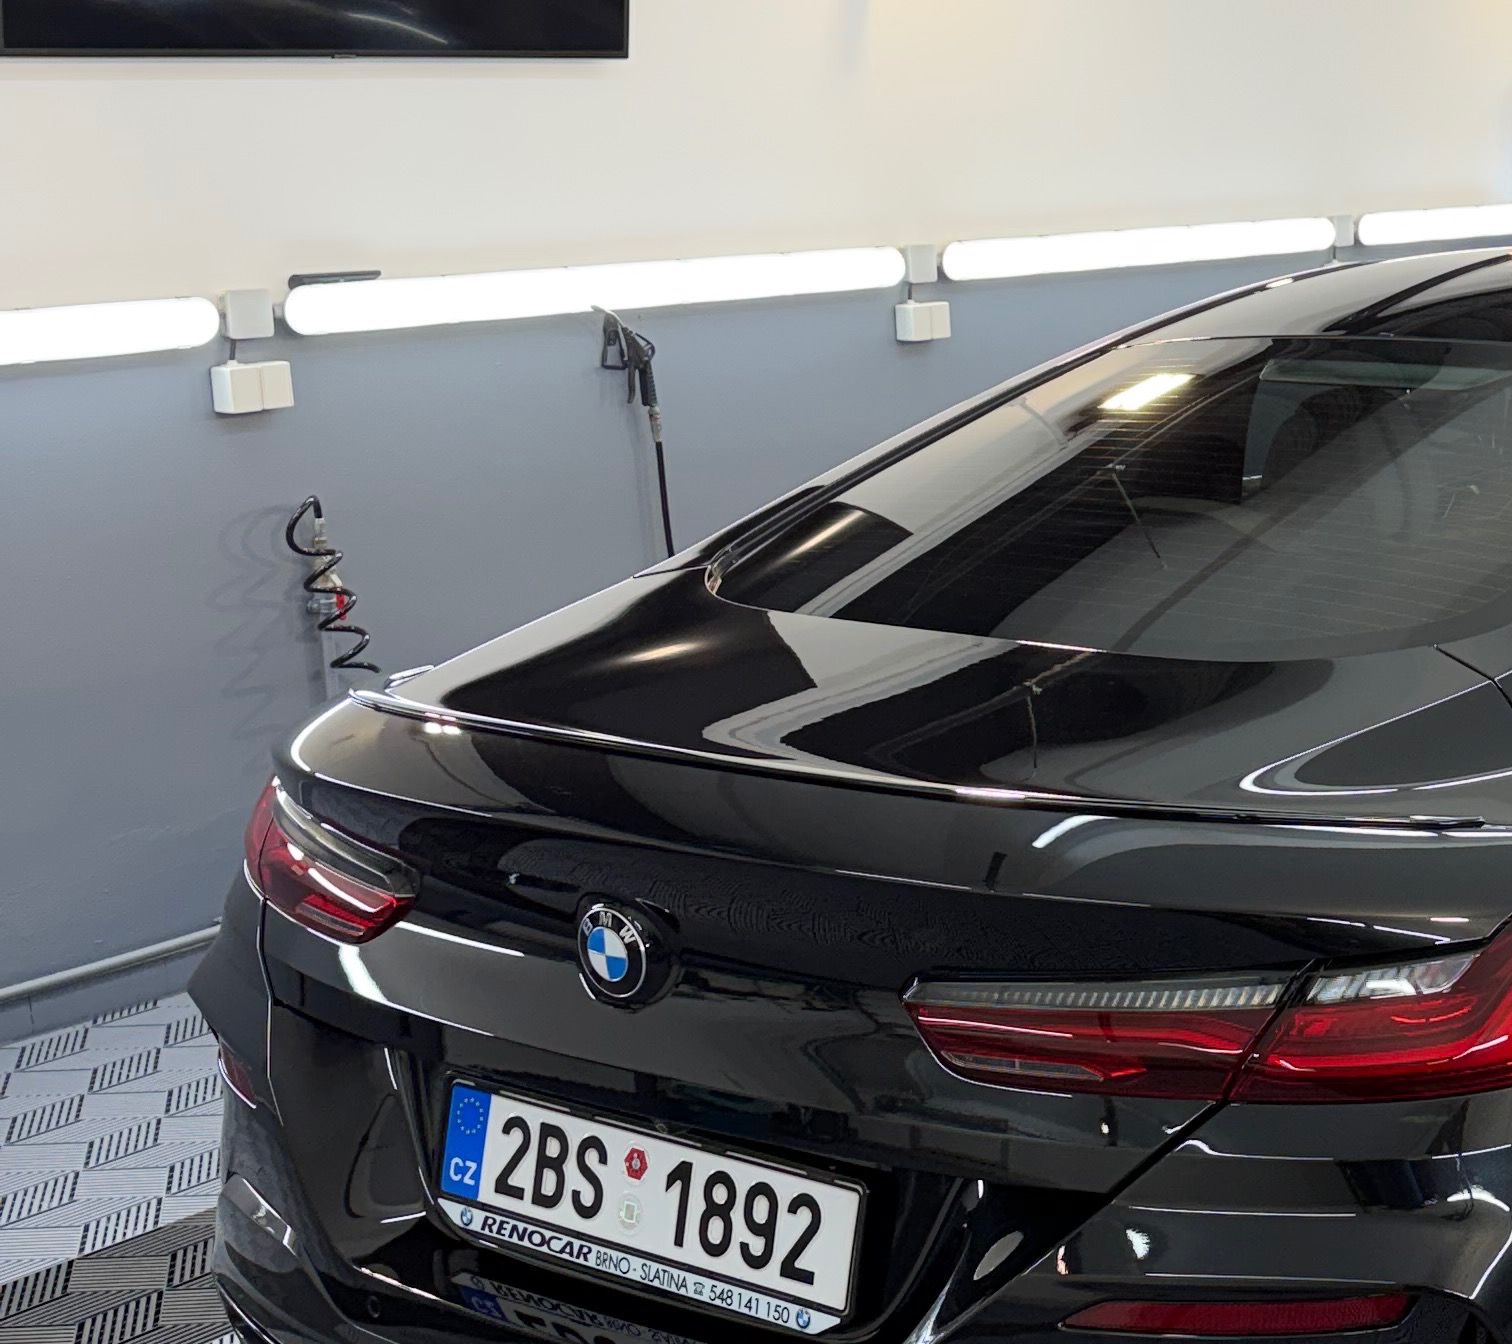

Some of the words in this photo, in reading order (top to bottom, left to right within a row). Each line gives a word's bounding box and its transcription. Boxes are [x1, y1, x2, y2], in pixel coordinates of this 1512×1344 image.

[582, 911, 637, 945] BMW
[450, 1156, 478, 1186] CZ
[494, 1115, 608, 1220] 2BS
[665, 1160, 823, 1286] 1892
[480, 1214, 593, 1263] RENOCAR
[595, 1250, 631, 1275] BRNO
[640, 1262, 689, 1294] SLATINA
[708, 1284, 734, 1307] 548
[737, 1292, 760, 1316] 141
[765, 1301, 791, 1324] 150
